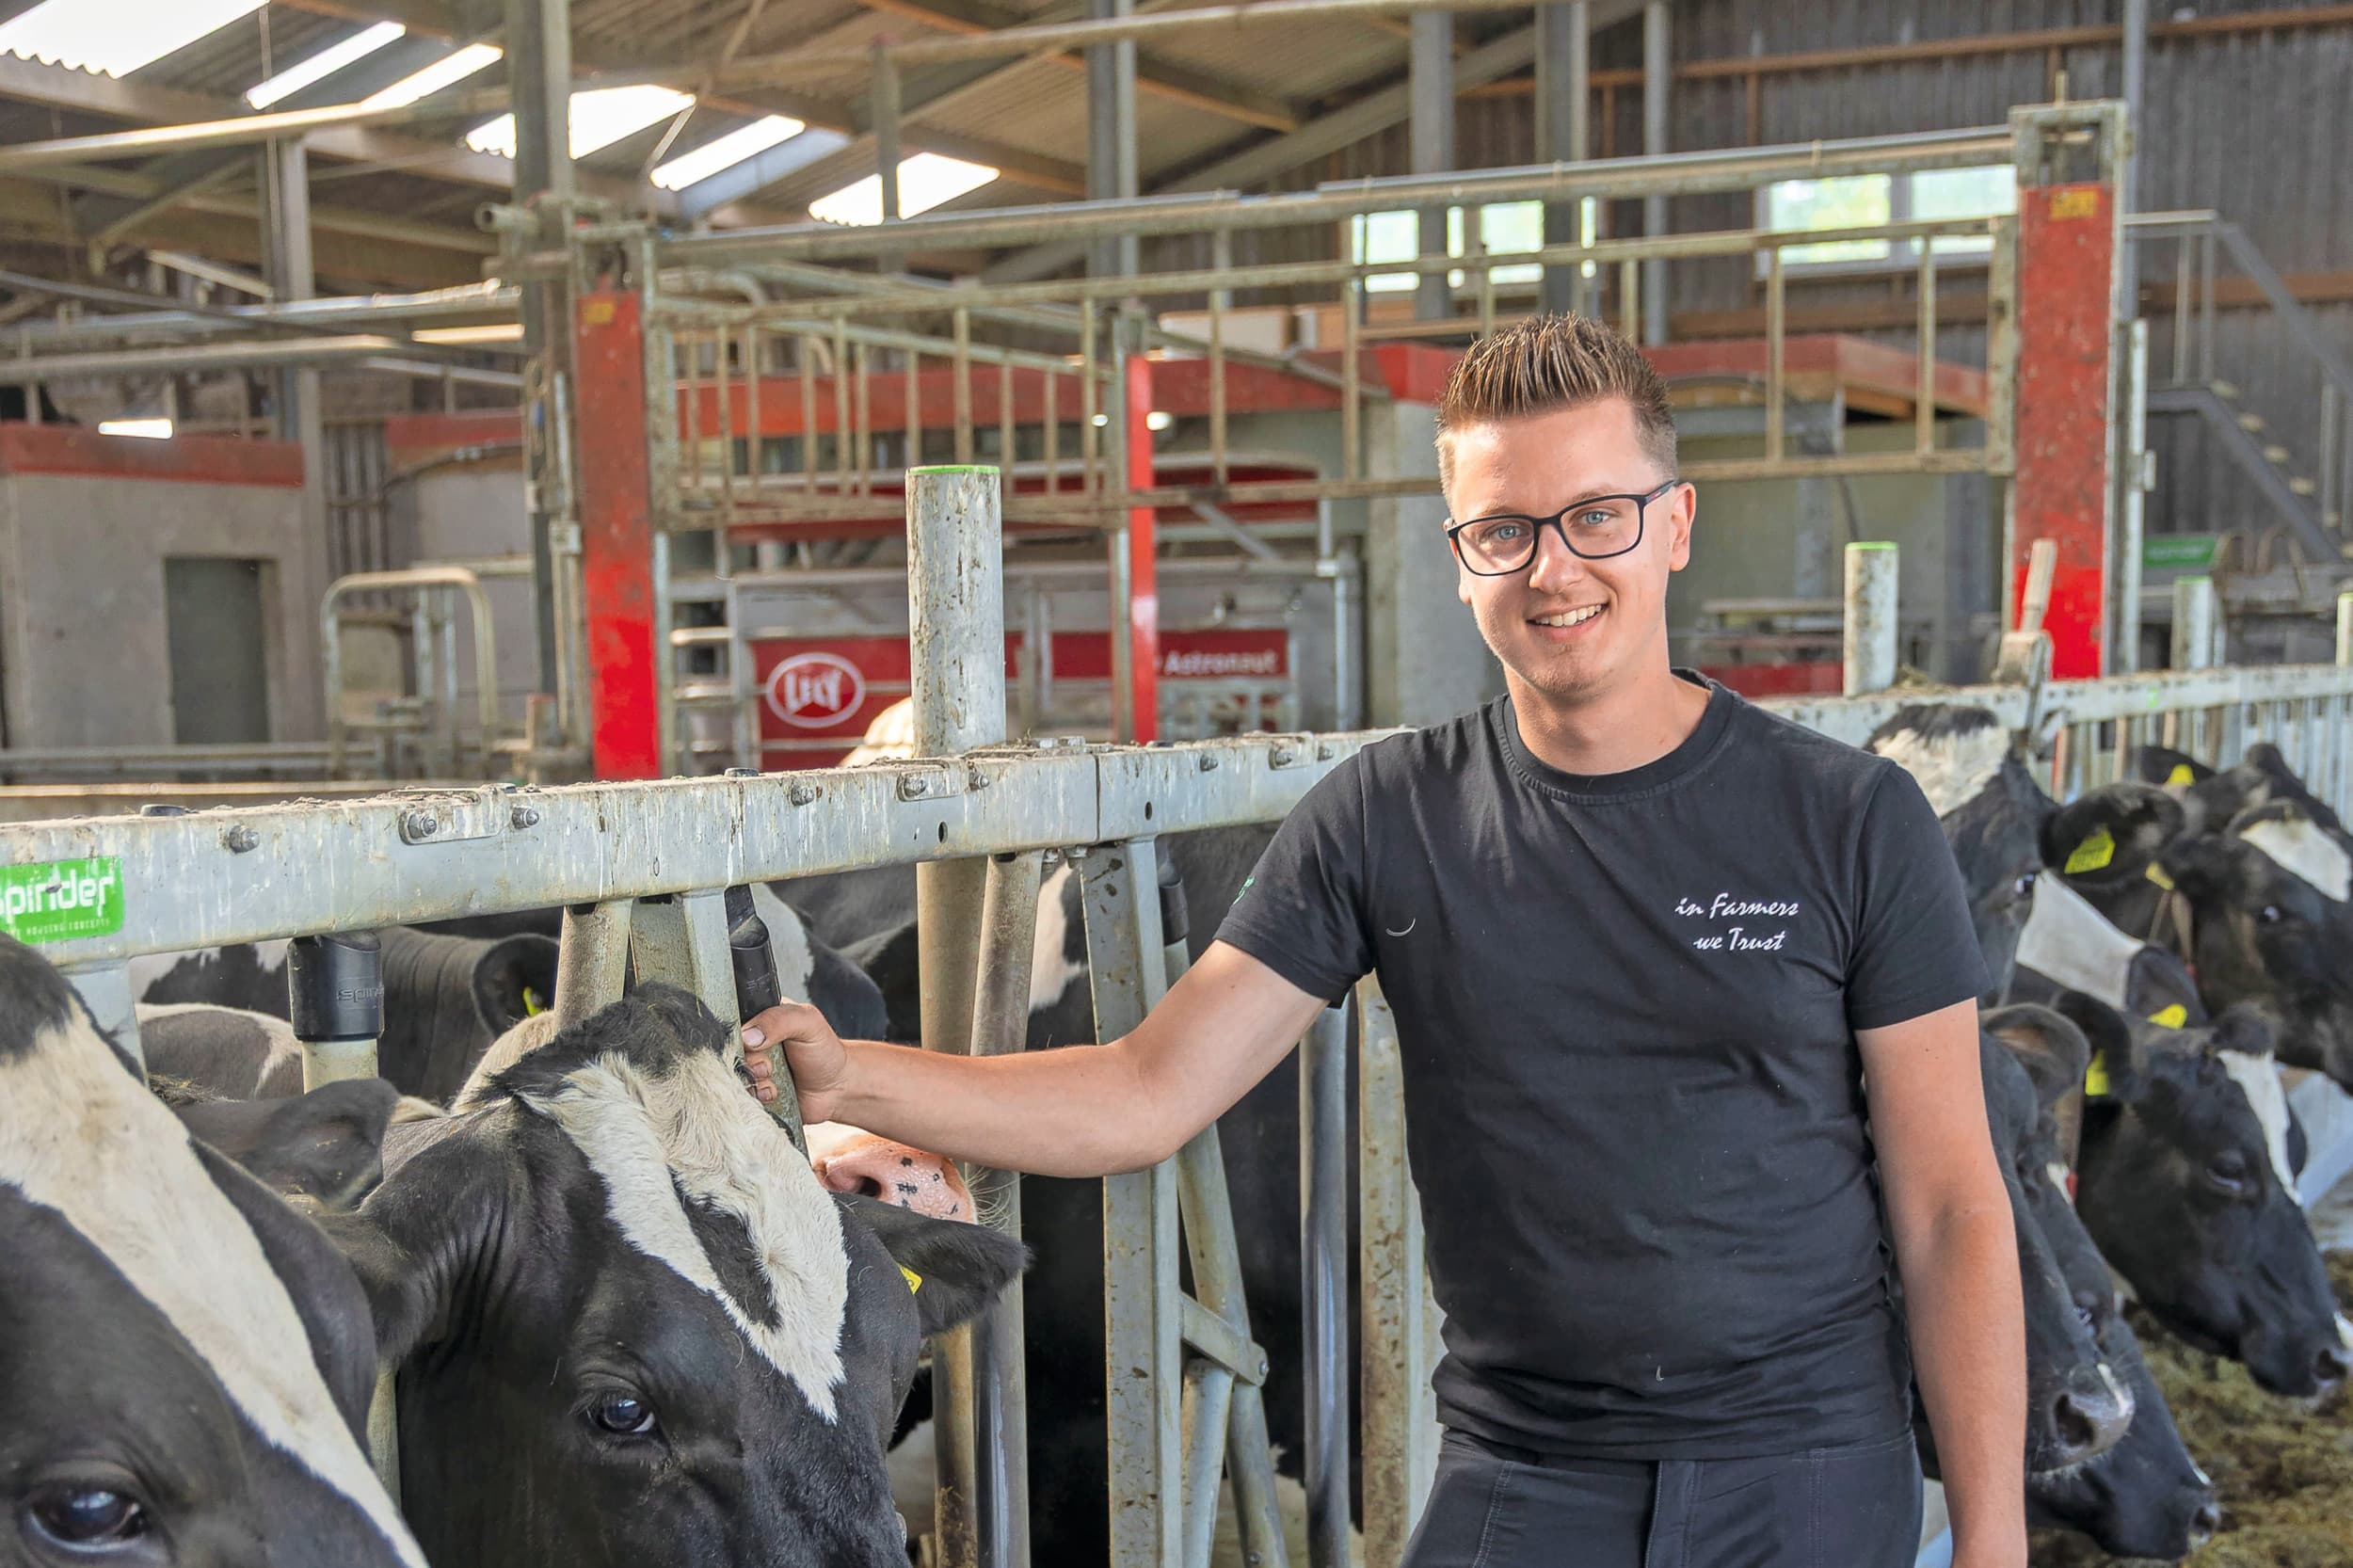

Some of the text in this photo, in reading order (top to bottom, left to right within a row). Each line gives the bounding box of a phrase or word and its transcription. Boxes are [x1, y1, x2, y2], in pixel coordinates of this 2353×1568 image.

[1164, 650, 1277, 675] Astronaut
[0, 868, 114, 924] pinder
[1674, 898, 1705, 916] in
[1693, 927, 1786, 951] we Trust
